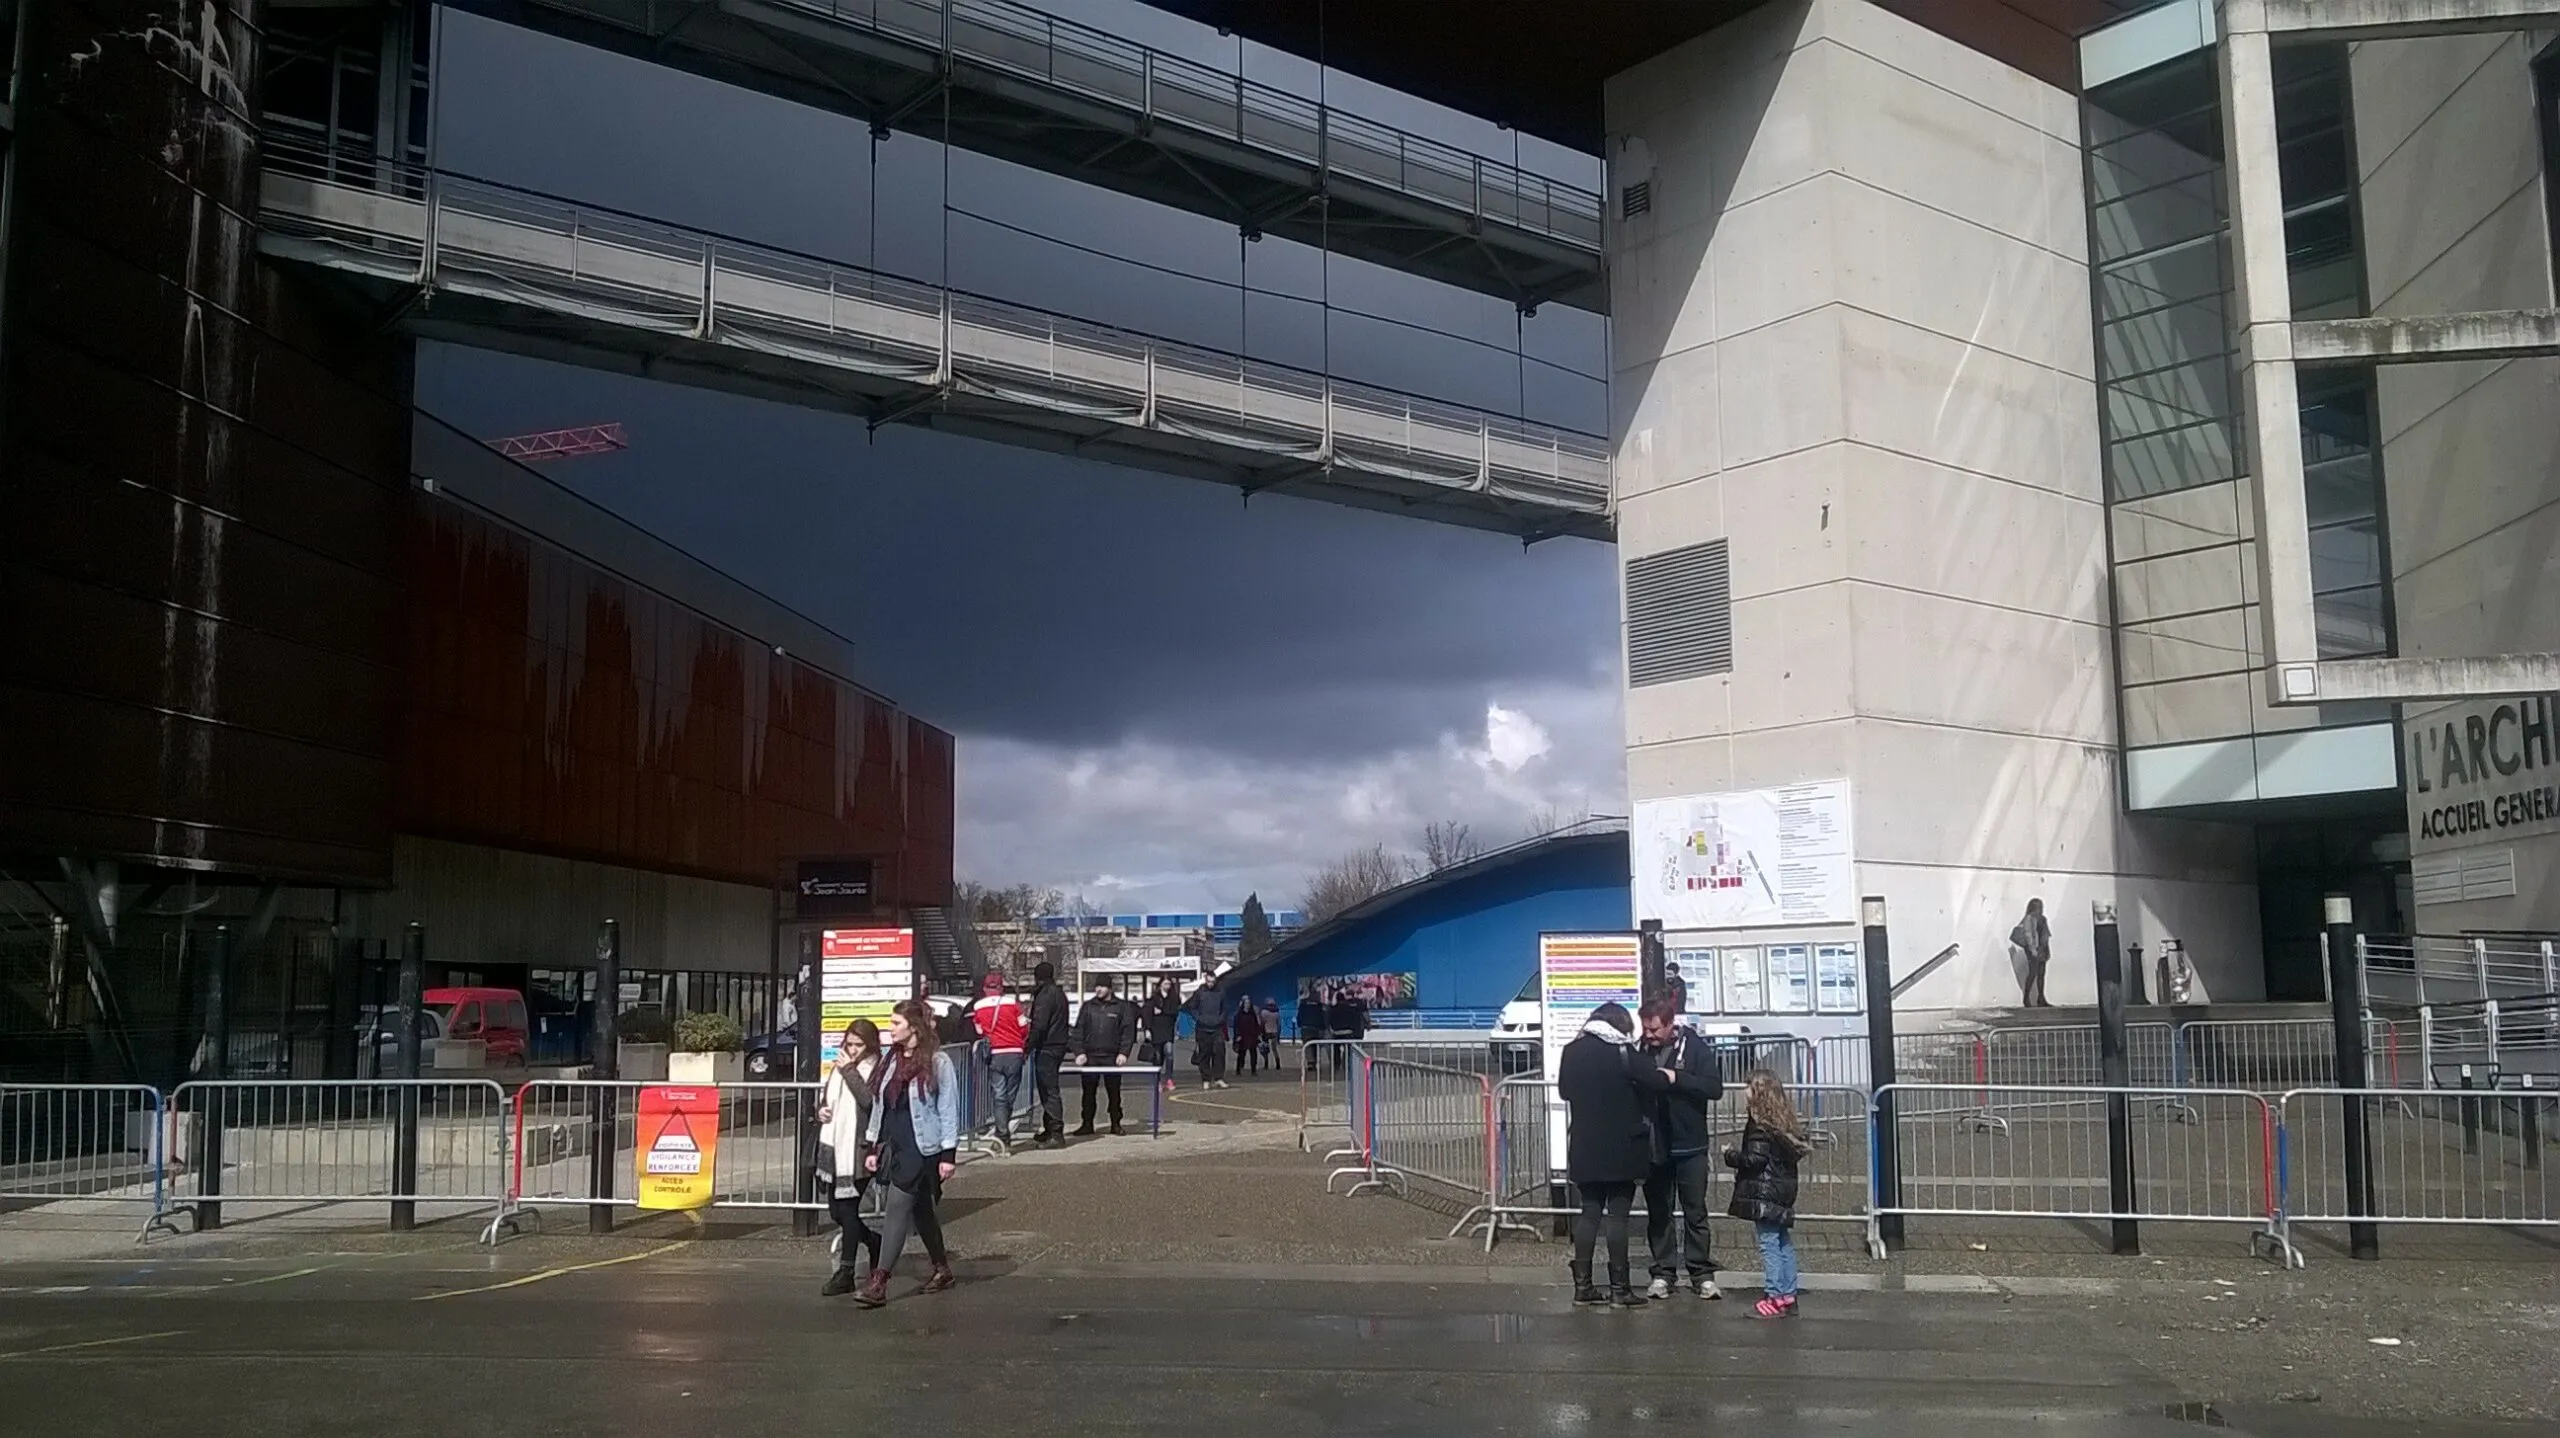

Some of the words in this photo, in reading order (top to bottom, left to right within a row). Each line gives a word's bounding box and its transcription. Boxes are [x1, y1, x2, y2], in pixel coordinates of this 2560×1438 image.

[2421, 799, 2490, 840] ACCUEIL
[814, 887, 836, 895] Jean
[651, 1153, 696, 1161] VIGILANCE
